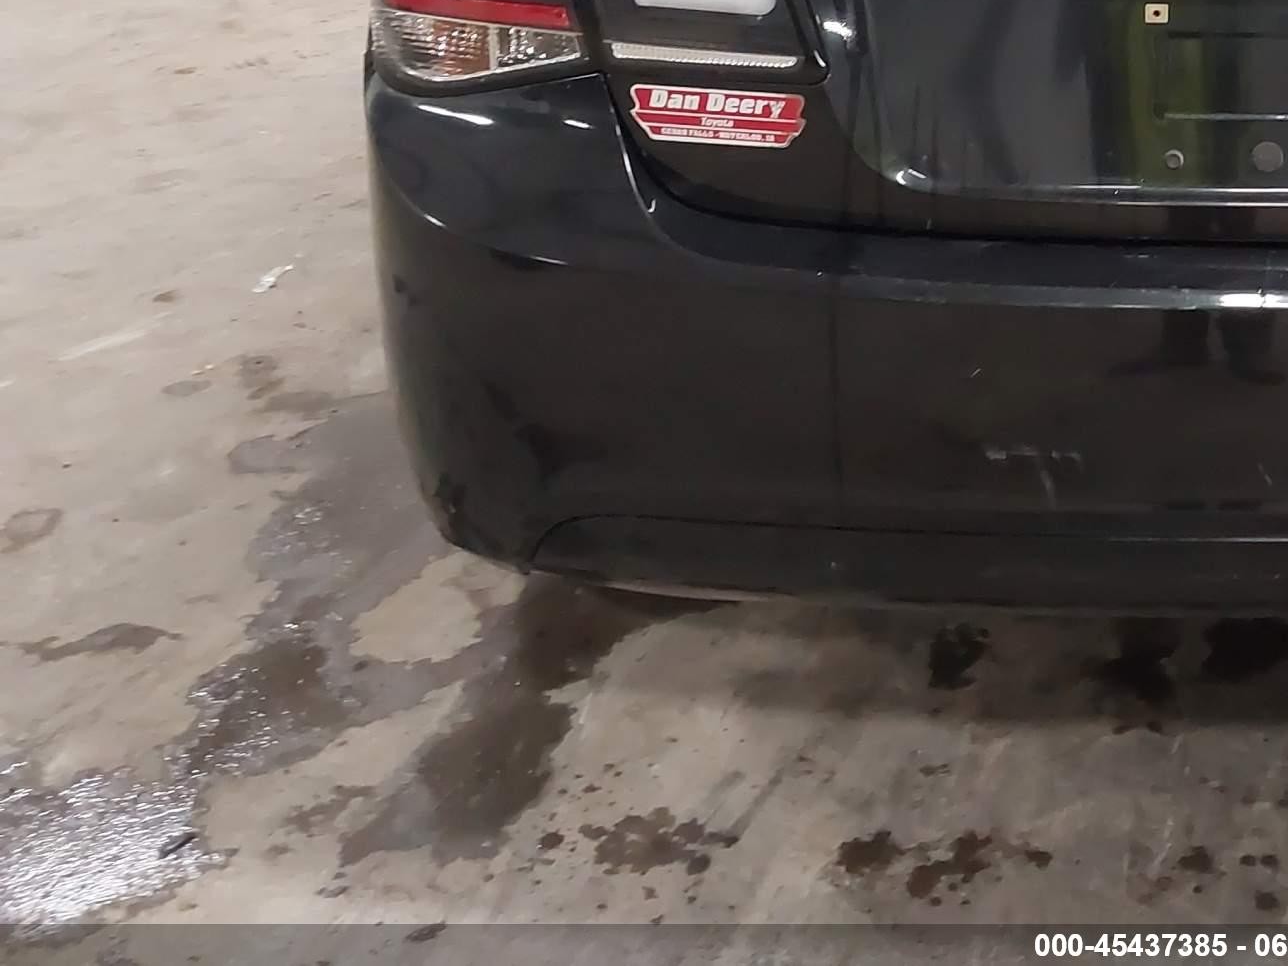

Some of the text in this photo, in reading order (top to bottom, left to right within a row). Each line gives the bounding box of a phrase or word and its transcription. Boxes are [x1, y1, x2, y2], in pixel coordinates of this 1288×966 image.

[649, 89, 785, 119] Dan Deery
[700, 117, 735, 128] Toyota
